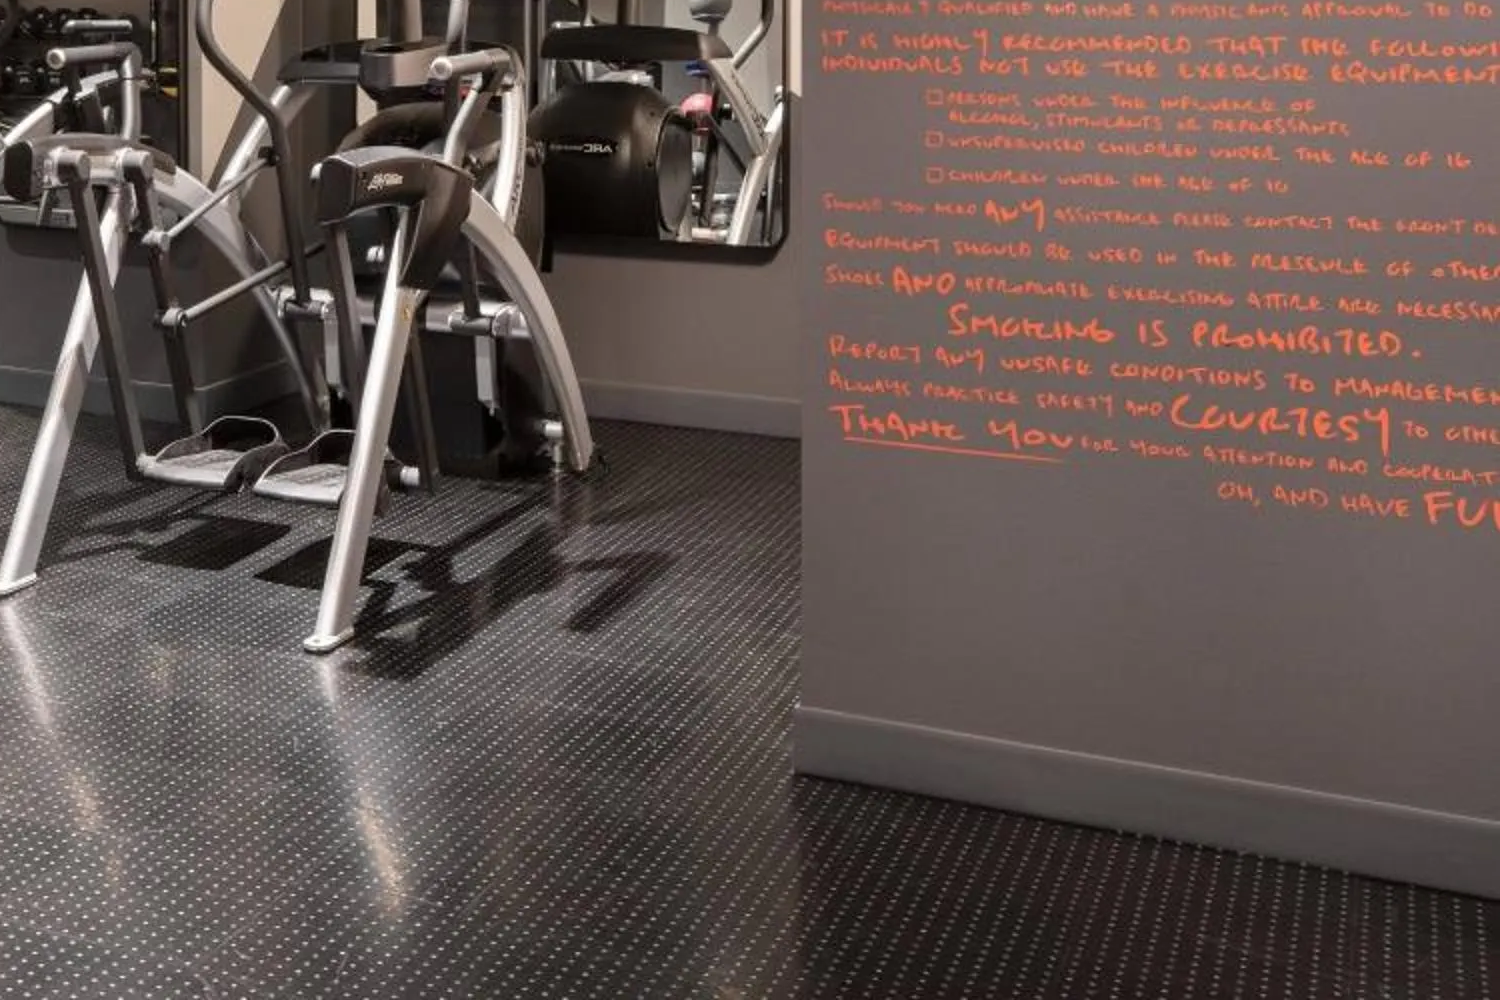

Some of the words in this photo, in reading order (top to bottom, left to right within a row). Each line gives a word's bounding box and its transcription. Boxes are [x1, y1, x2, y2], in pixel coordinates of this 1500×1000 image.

[1423, 0, 1451, 18] TO
[820, 29, 850, 47] IT
[858, 31, 878, 49] IS
[892, 27, 990, 57] HIGHLY
[1001, 33, 1192, 54] RECOMMENDED
[1205, 34, 1288, 58] THAT
[1299, 36, 1350, 57] THE
[820, 53, 964, 75] INDIVIDUALS
[978, 55, 1030, 76] NOT
[1044, 57, 1090, 77] USE
[1102, 59, 1161, 79] THE
[1178, 61, 1313, 82] EXERCISE
[1329, 59, 1500, 85] EQUIPMENT
[1110, 91, 1148, 110] THE
[1289, 97, 1318, 114] OF
[1209, 144, 1281, 162] UNDER
[1295, 146, 1336, 165] THE
[1349, 150, 1391, 168] AGE
[1403, 151, 1434, 168] OF
[983, 196, 1046, 233] ANY
[1347, 215, 1383, 233] THE
[824, 228, 940, 252] EQUIPMENT
[952, 239, 1033, 259] SHOULD
[1044, 241, 1073, 262] BE
[1087, 248, 1143, 266] USED
[1154, 250, 1177, 266] IN
[1192, 249, 1237, 268] THE
[1384, 259, 1413, 279] OF
[891, 264, 957, 297] AND
[947, 301, 1116, 344] SMOKING
[1137, 319, 1170, 347] IS
[1191, 319, 1423, 359] PROHIBITED.
[828, 332, 923, 366] REPORT
[933, 345, 986, 376] ANY
[1001, 355, 1094, 377] UNSAFE
[1108, 359, 1268, 392] CONDITIONS
[1283, 372, 1316, 394] TO
[828, 368, 911, 398] ALWAYS
[923, 382, 1020, 406] PRACTICE
[1035, 392, 1114, 418] SAFETY
[1124, 399, 1164, 418] AND
[1168, 393, 1391, 460] COURTESY
[1403, 419, 1430, 440] TO
[827, 403, 966, 442] THANK
[987, 418, 1075, 450] YOU
[1129, 437, 1192, 460] YOUR
[1202, 443, 1316, 471] ATTENTION
[1327, 455, 1370, 476] AND
[1216, 480, 1262, 508] OH,
[1271, 483, 1330, 510] AND
[1340, 493, 1412, 519] HAVE
